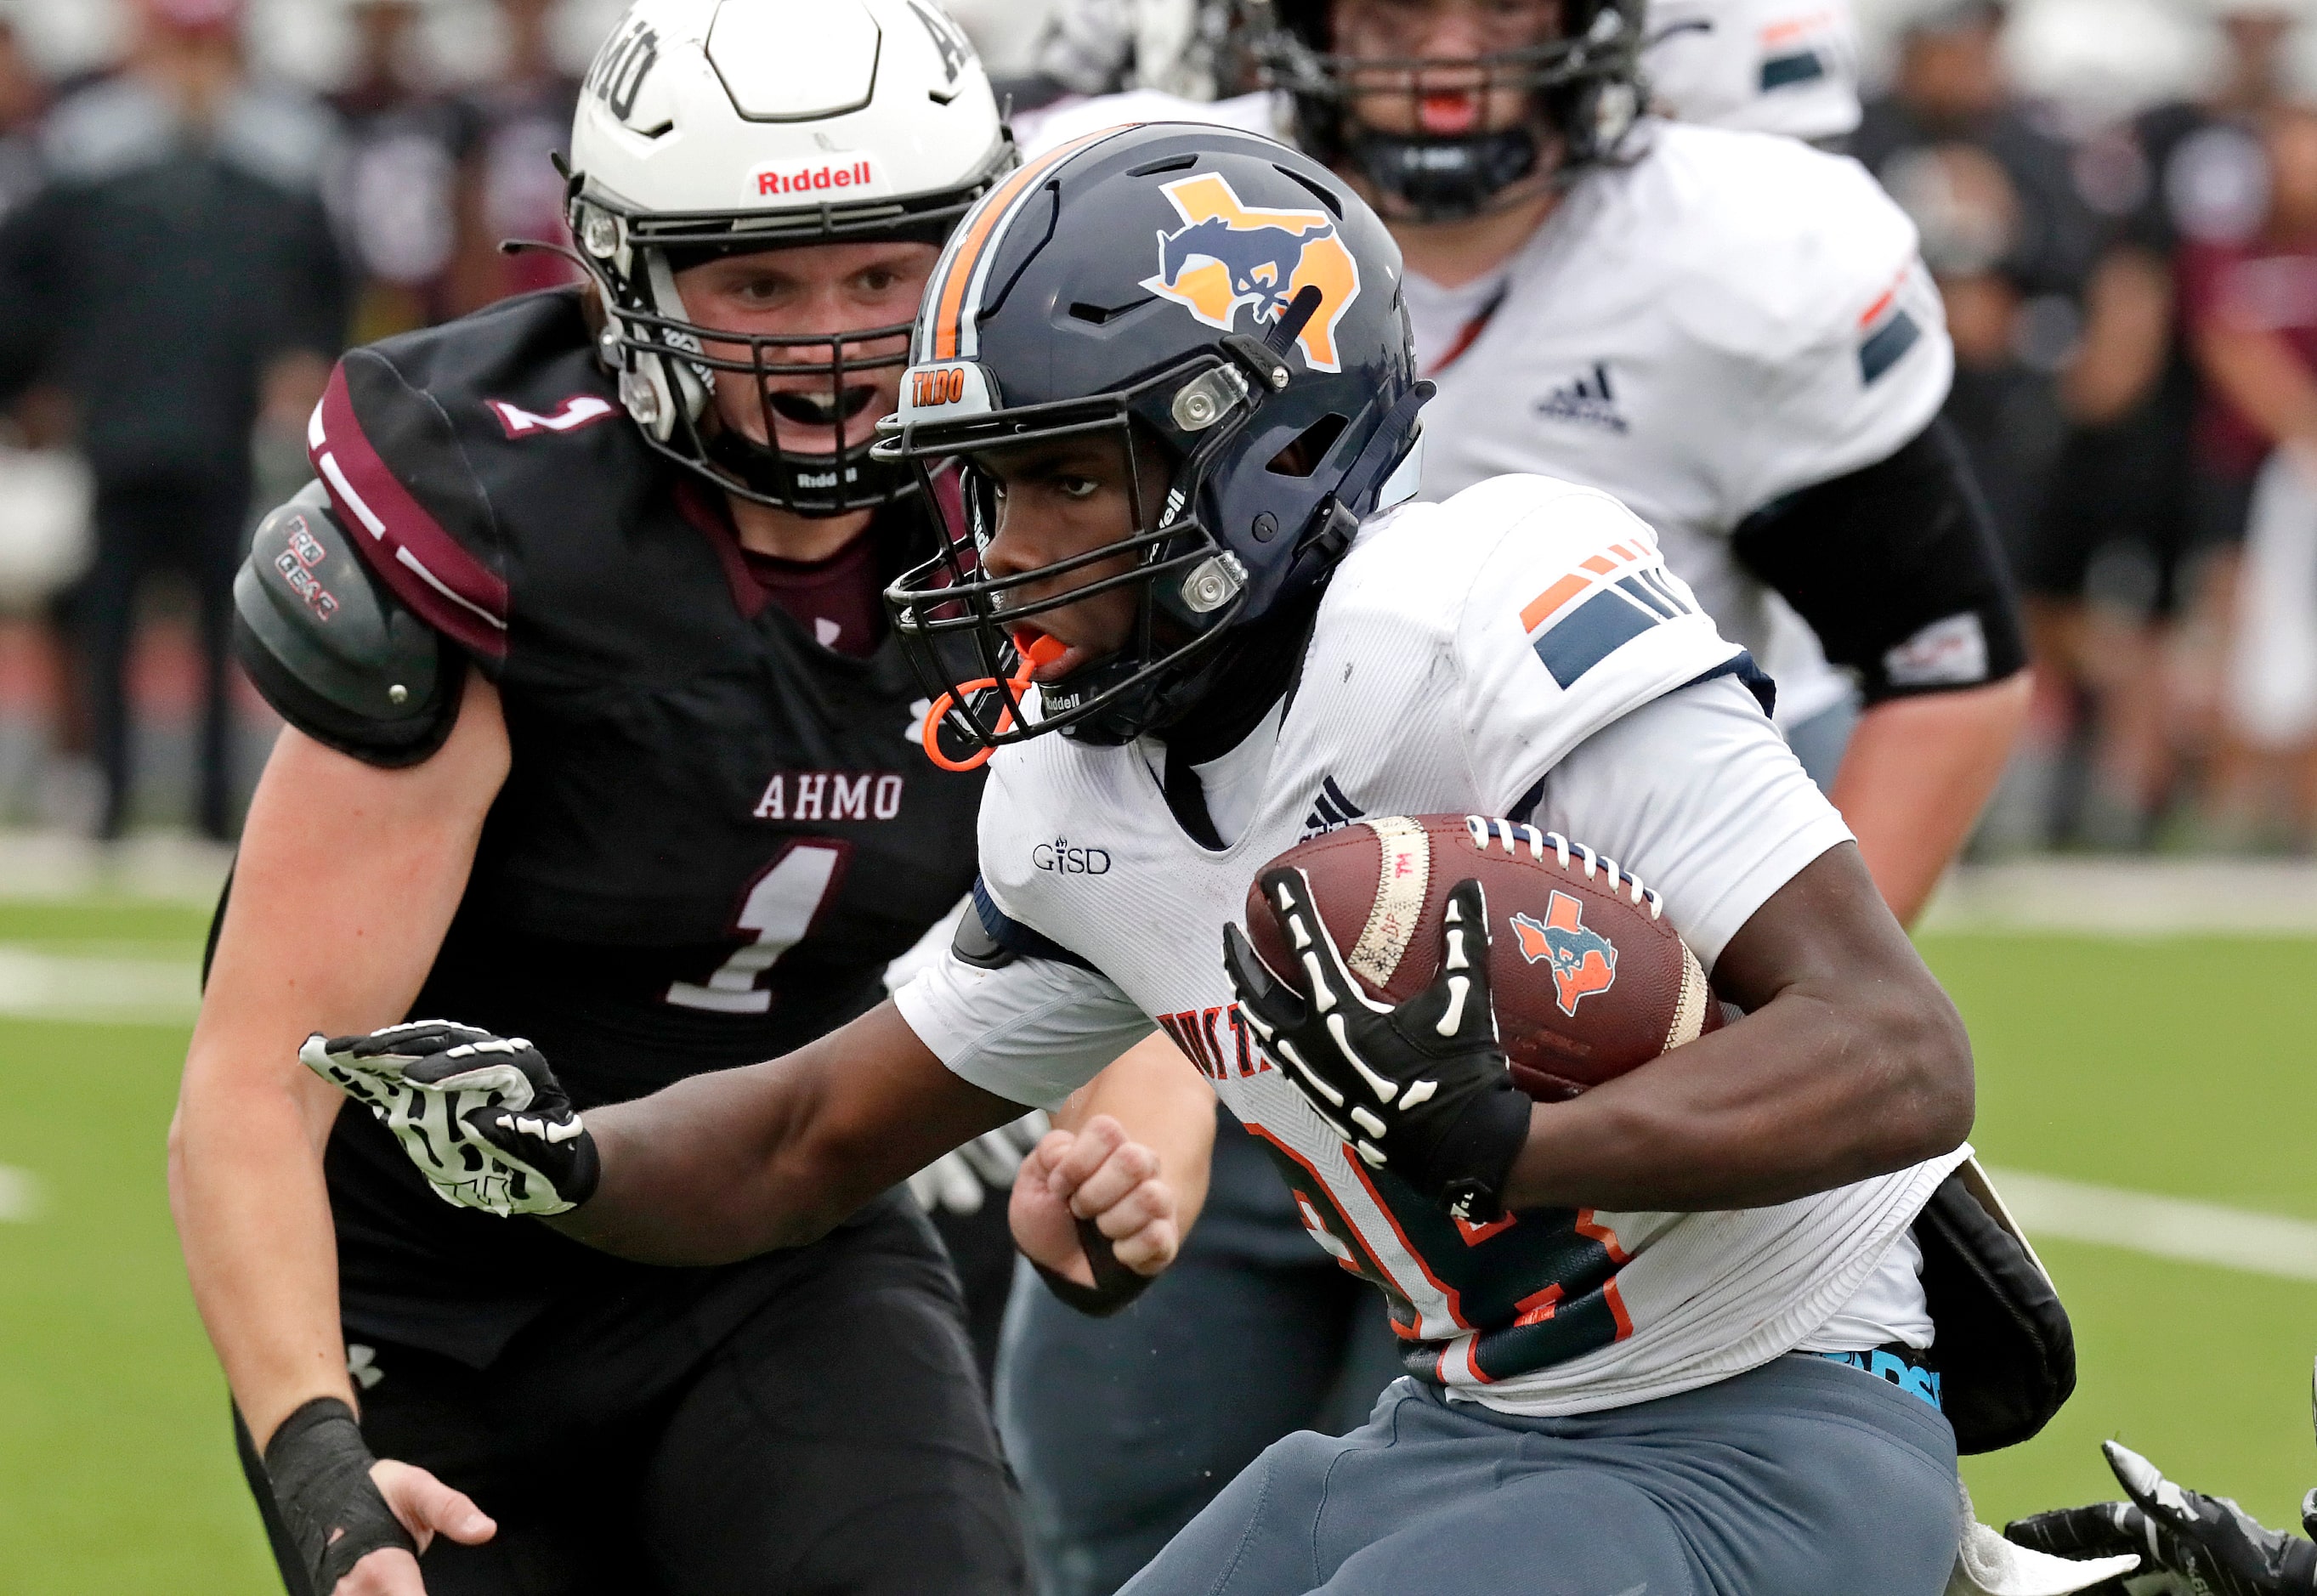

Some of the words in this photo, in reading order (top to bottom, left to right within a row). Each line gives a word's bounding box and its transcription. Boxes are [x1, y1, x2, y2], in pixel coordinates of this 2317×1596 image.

[758, 161, 871, 195] Riddell
[797, 467, 858, 489] Riddll
[753, 773, 904, 821] AHMO
[663, 841, 843, 1015] 1
